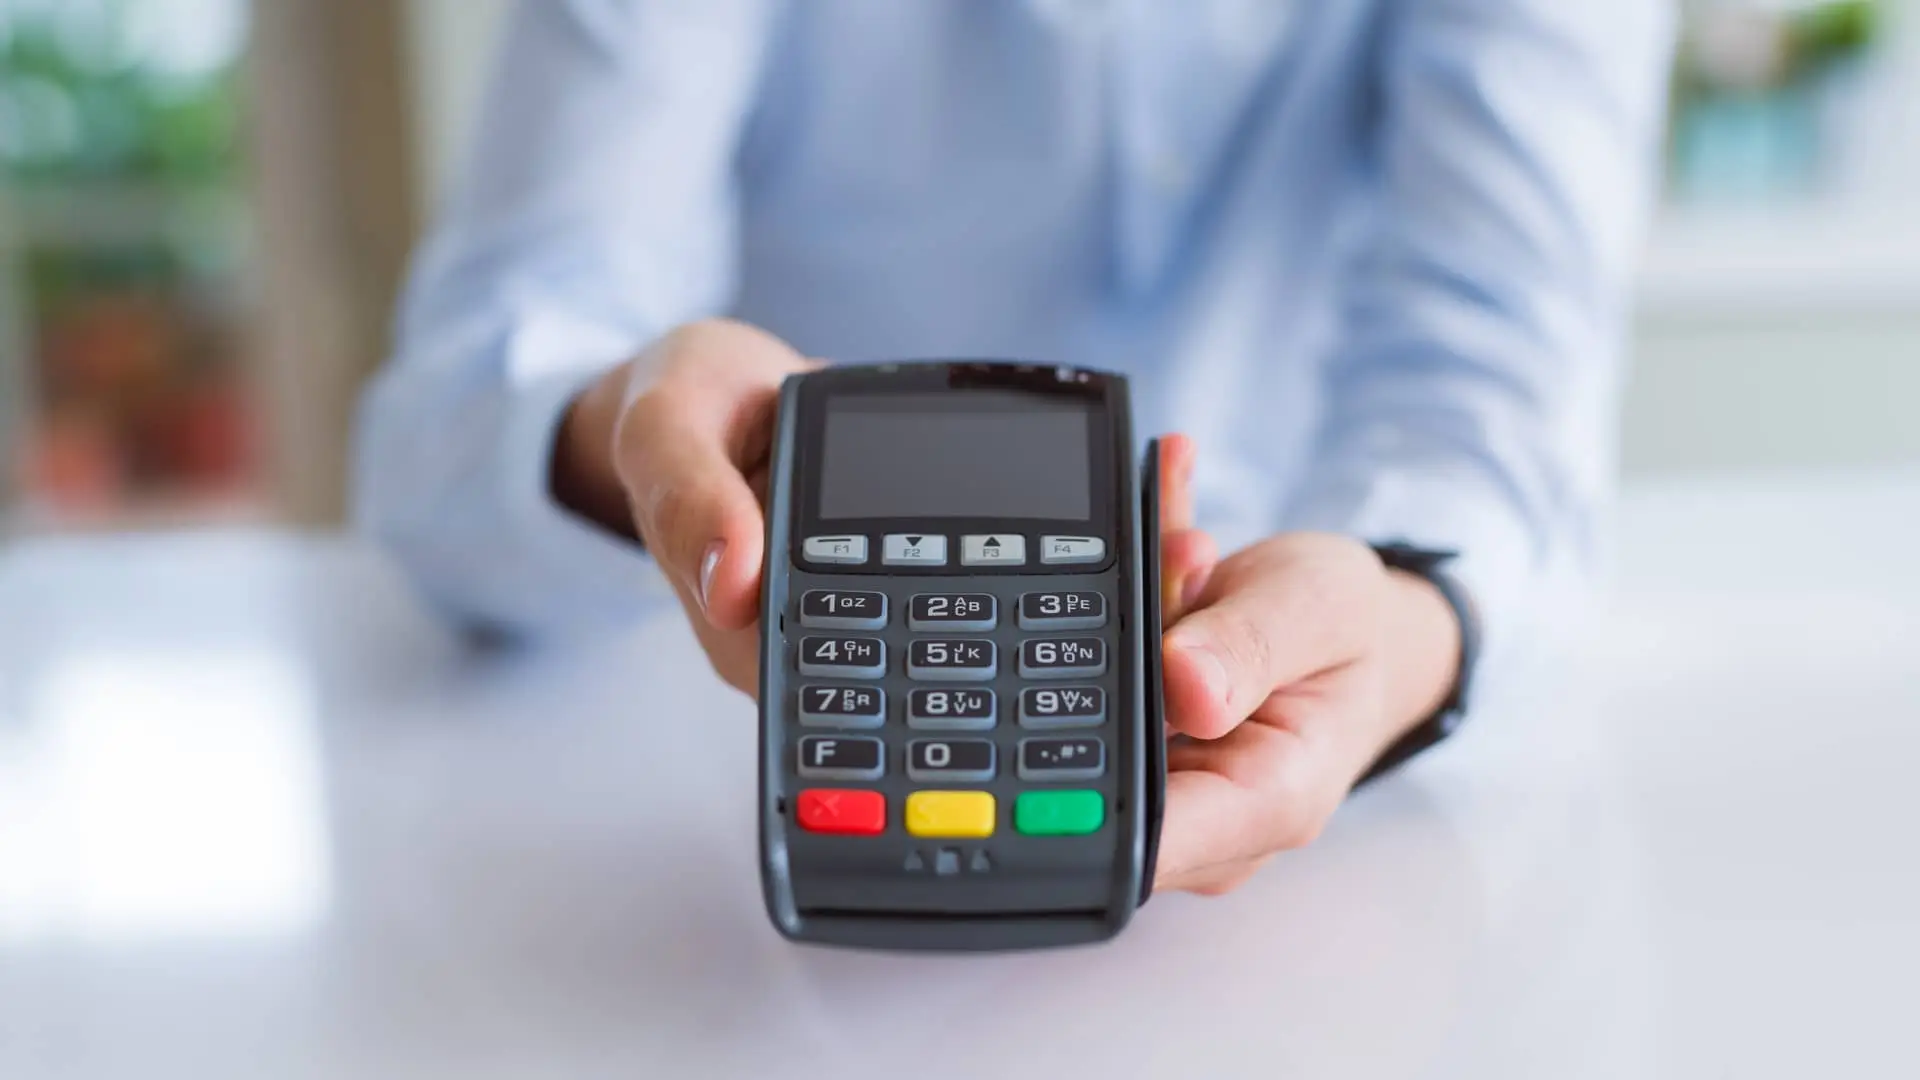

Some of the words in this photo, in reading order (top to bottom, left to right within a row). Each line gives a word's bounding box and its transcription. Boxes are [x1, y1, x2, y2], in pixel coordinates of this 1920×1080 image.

[833, 545, 849, 555] F1
[903, 548, 921, 558] F2
[982, 548, 1000, 558] F3
[1054, 545, 1071, 554] F4
[821, 594, 835, 612] 1
[841, 598, 865, 607] QZ
[928, 598, 948, 616] 2
[1040, 595, 1060, 613] 3
[816, 641, 838, 660] 4
[927, 643, 947, 663] 5
[1036, 643, 1056, 663] 6
[816, 689, 837, 710] 7
[926, 692, 948, 713] 8
[1036, 692, 1058, 712] 9
[816, 741, 836, 764] F
